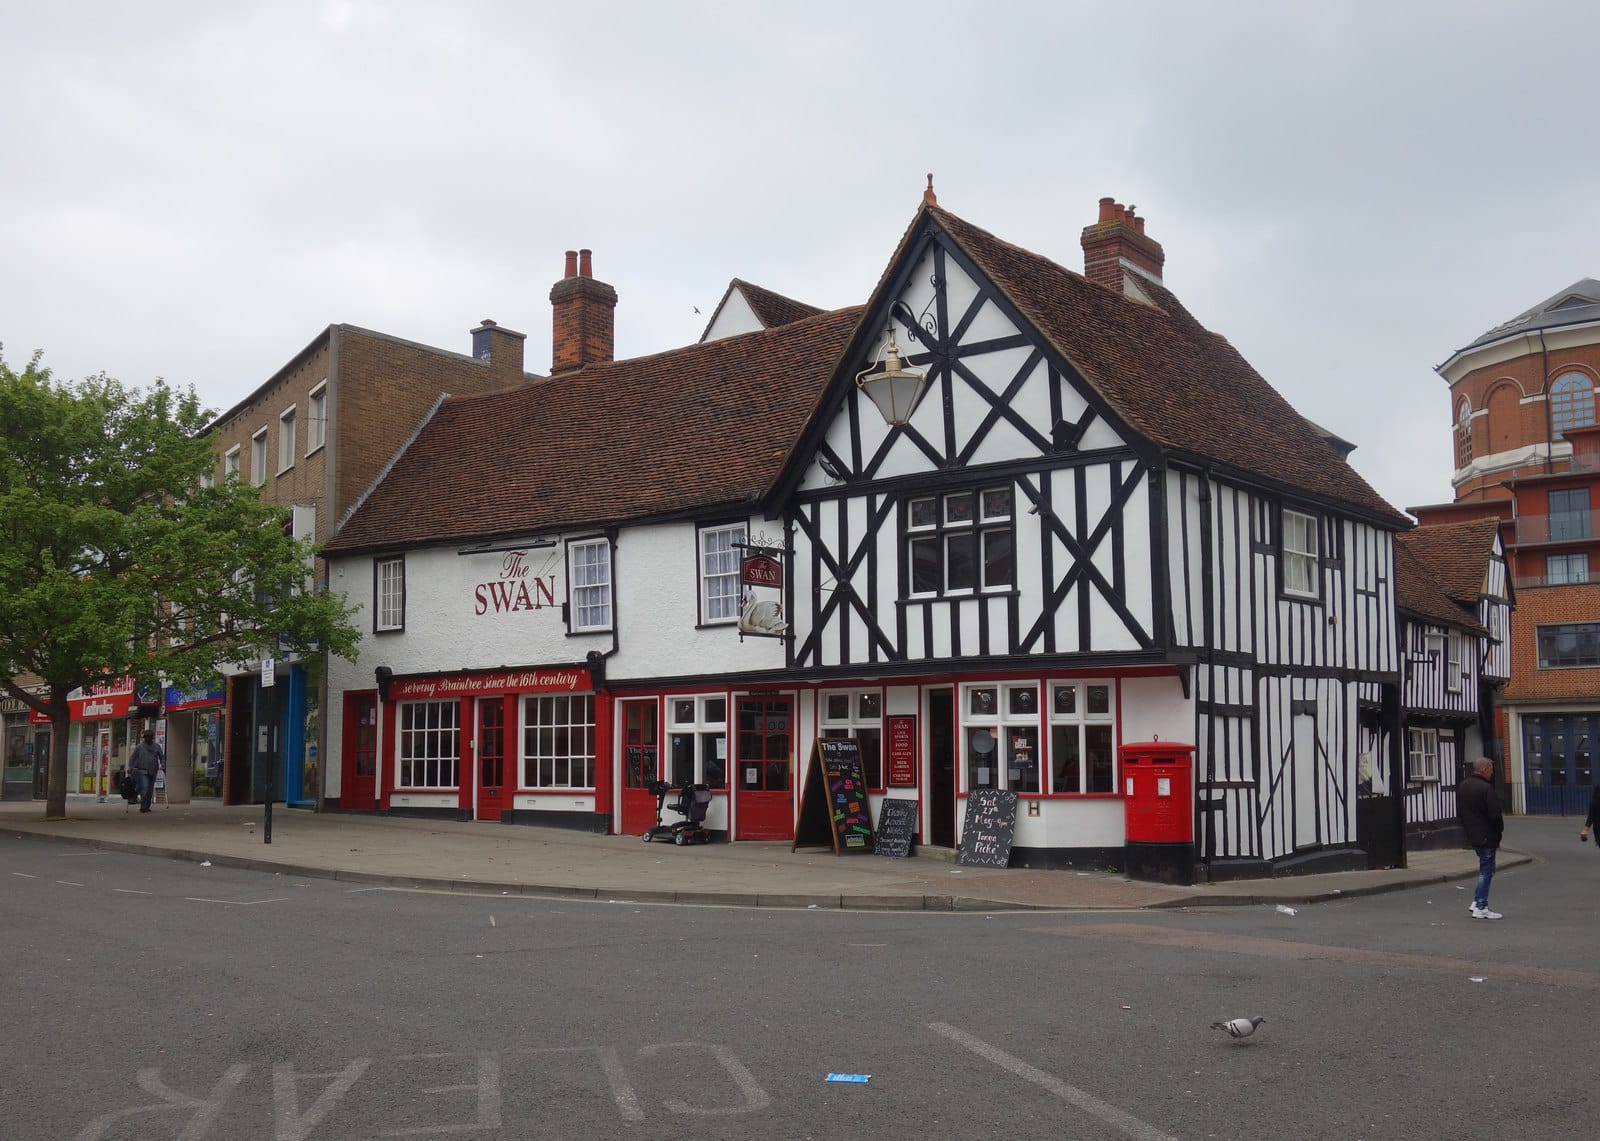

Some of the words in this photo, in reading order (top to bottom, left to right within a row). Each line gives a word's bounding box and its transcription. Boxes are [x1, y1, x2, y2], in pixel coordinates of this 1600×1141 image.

[500, 550, 529, 579] The
[751, 568, 776, 580] SWAN
[475, 575, 555, 616] SWAN
[438, 677, 482, 692] Braintree
[506, 673, 519, 688] the
[519, 671, 538, 687] 16th
[539, 671, 578, 690] century
[822, 742, 837, 751] The
[838, 742, 857, 751] Swan
[978, 797, 997, 806] Sat
